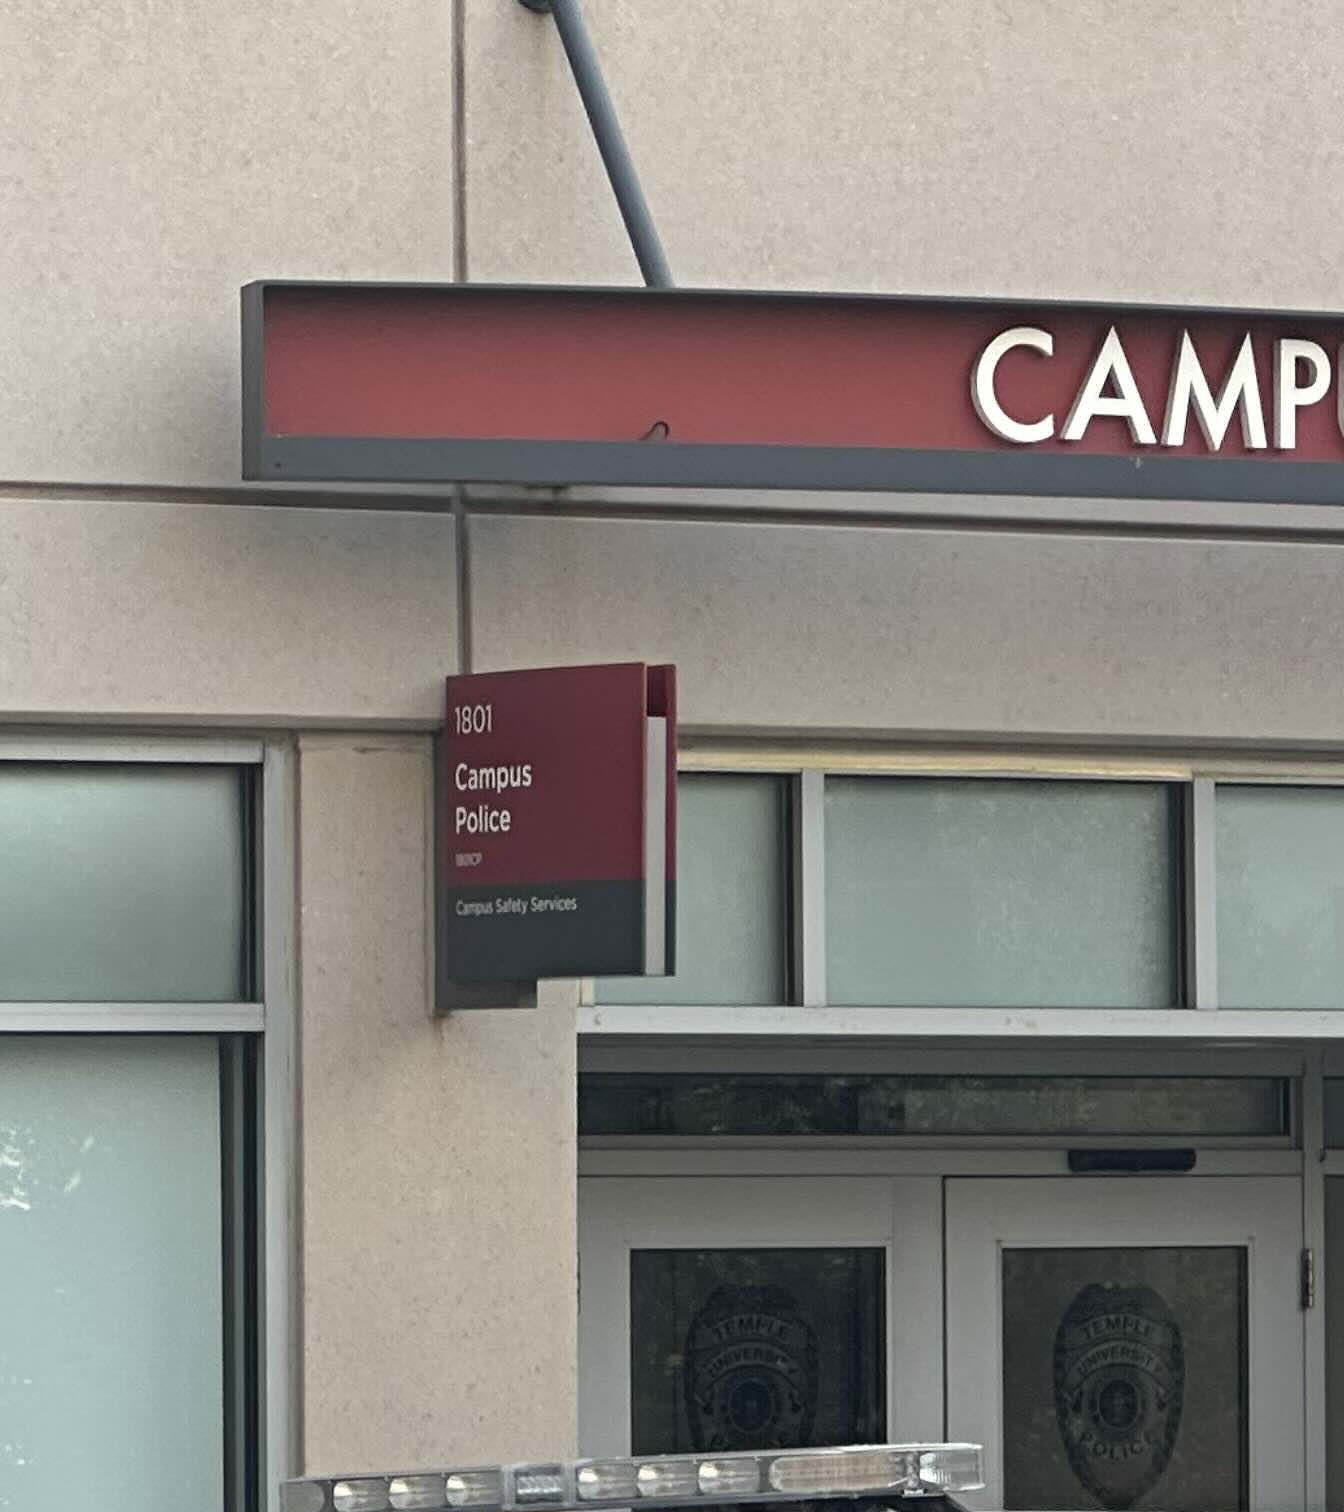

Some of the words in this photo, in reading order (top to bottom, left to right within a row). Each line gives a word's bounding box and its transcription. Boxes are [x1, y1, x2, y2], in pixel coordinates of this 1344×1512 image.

[455, 705, 493, 734] 1801
[455, 763, 533, 793] Campus
[455, 805, 511, 834] Police
[456, 899, 494, 916] Campus
[496, 897, 529, 914] Safety
[530, 896, 577, 912] Services
